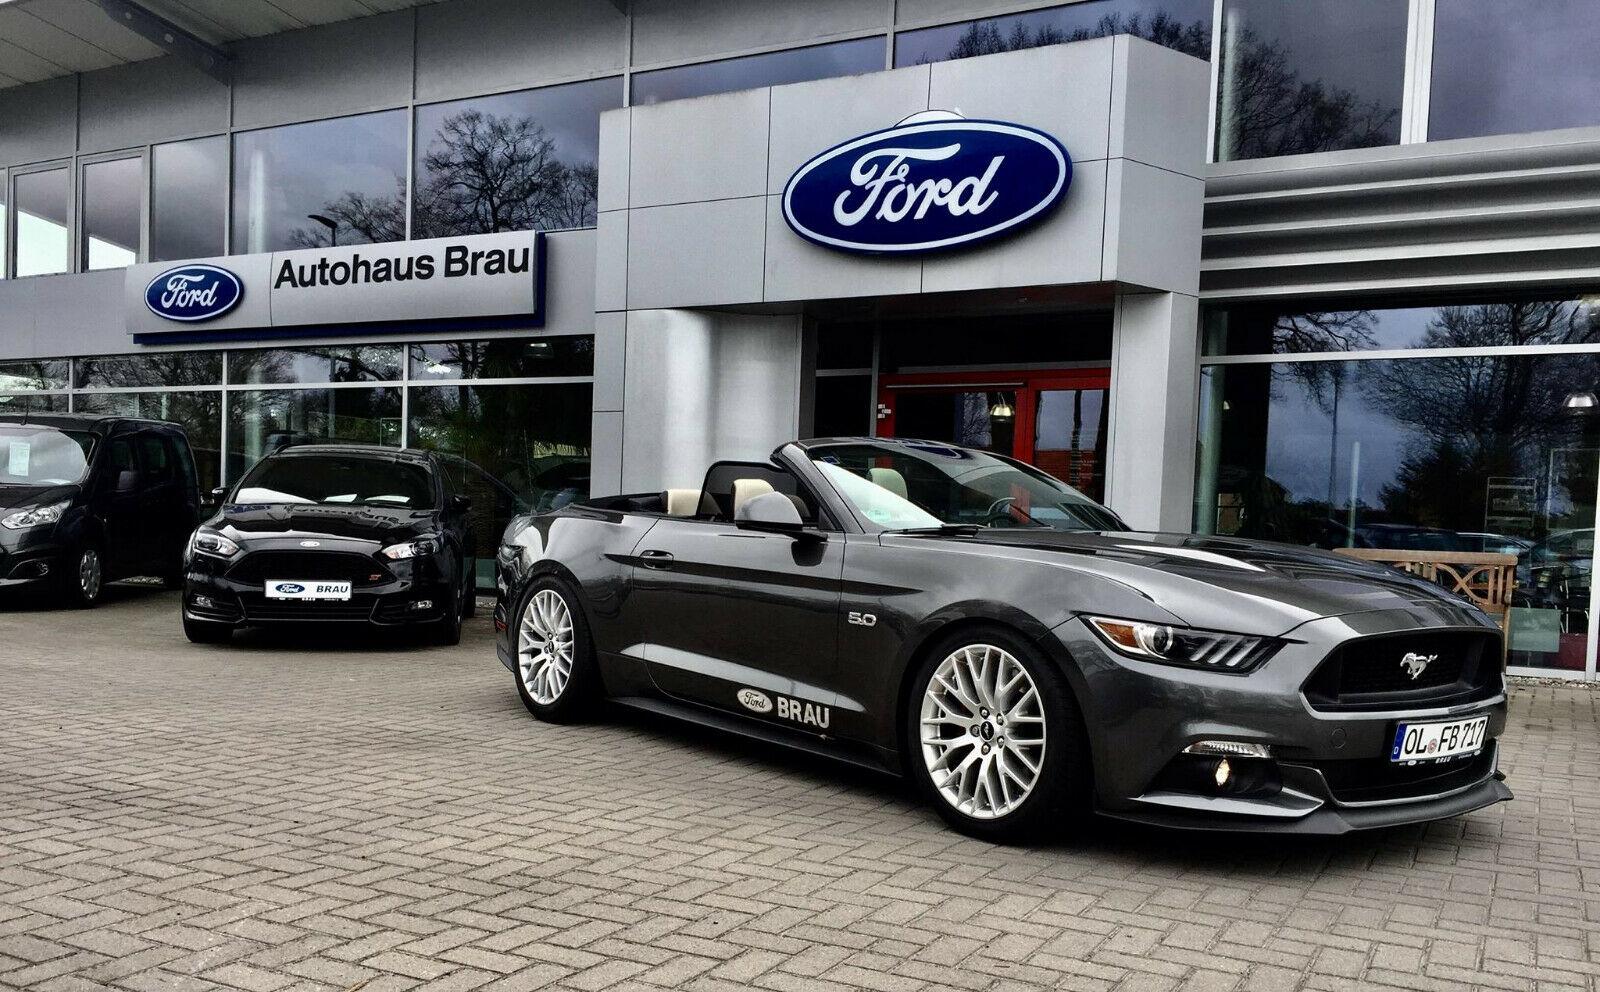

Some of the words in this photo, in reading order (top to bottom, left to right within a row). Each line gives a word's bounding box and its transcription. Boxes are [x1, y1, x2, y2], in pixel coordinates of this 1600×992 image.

[833, 143, 1005, 226] Ford
[274, 252, 435, 289] Autohaus
[443, 245, 530, 278] Brau
[161, 274, 219, 308] Ford
[316, 585, 349, 593] BRAU
[744, 691, 766, 709] Ford
[777, 696, 830, 729] BRAU
[1404, 728, 1427, 754] OL
[1438, 725, 1460, 752] FB
[1460, 719, 1485, 748] 717
